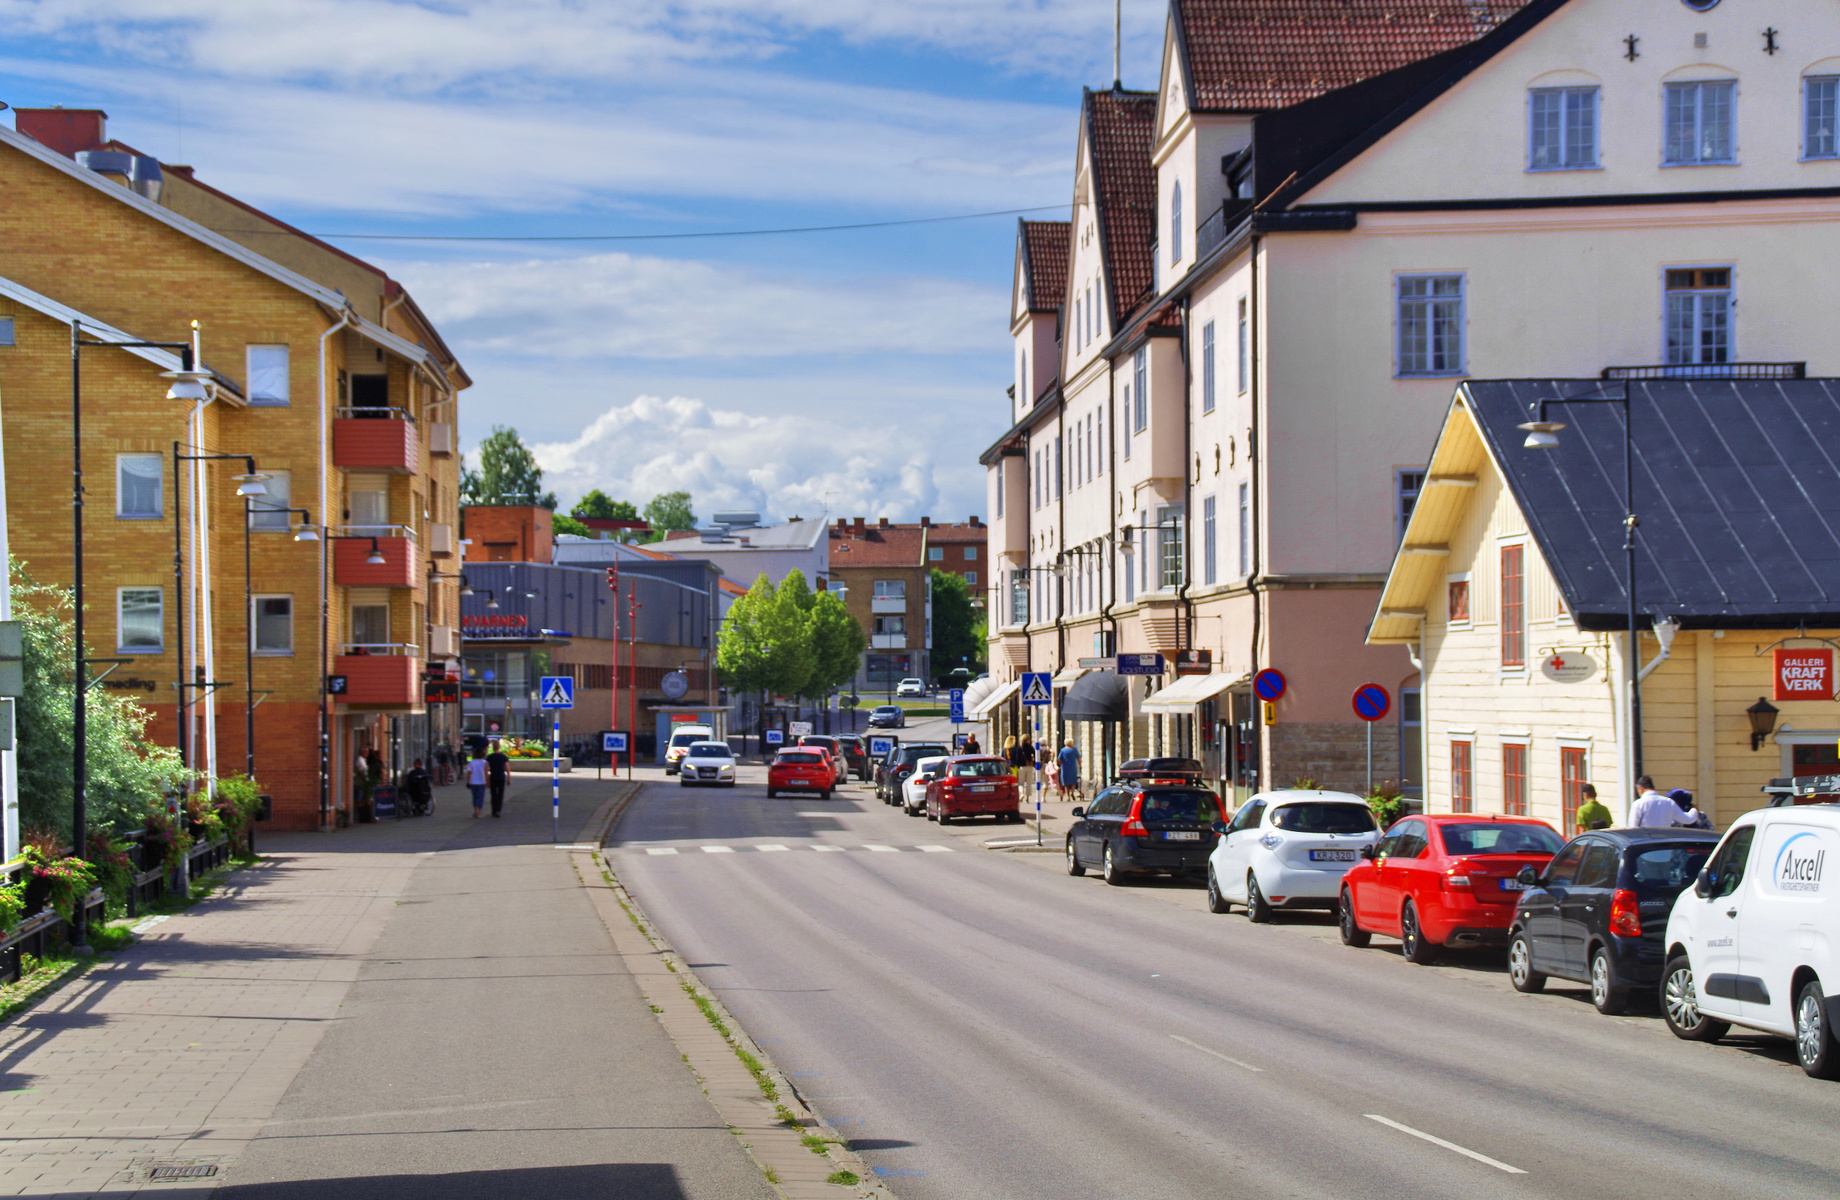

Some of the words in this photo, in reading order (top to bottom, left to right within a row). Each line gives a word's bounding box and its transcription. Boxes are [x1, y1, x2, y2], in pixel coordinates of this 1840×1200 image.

[462, 615, 528, 628] KVARNEN
[1783, 658, 1824, 666] GALLERI
[1121, 666, 1160, 674] SOLSTUDIO
[1781, 667, 1827, 678] KRAFT
[1782, 679, 1823, 691] VERK
[953, 690, 961, 701] P
[1316, 851, 1333, 860] KRJ
[1335, 851, 1351, 860] 320
[1781, 849, 1825, 882] Axcell
